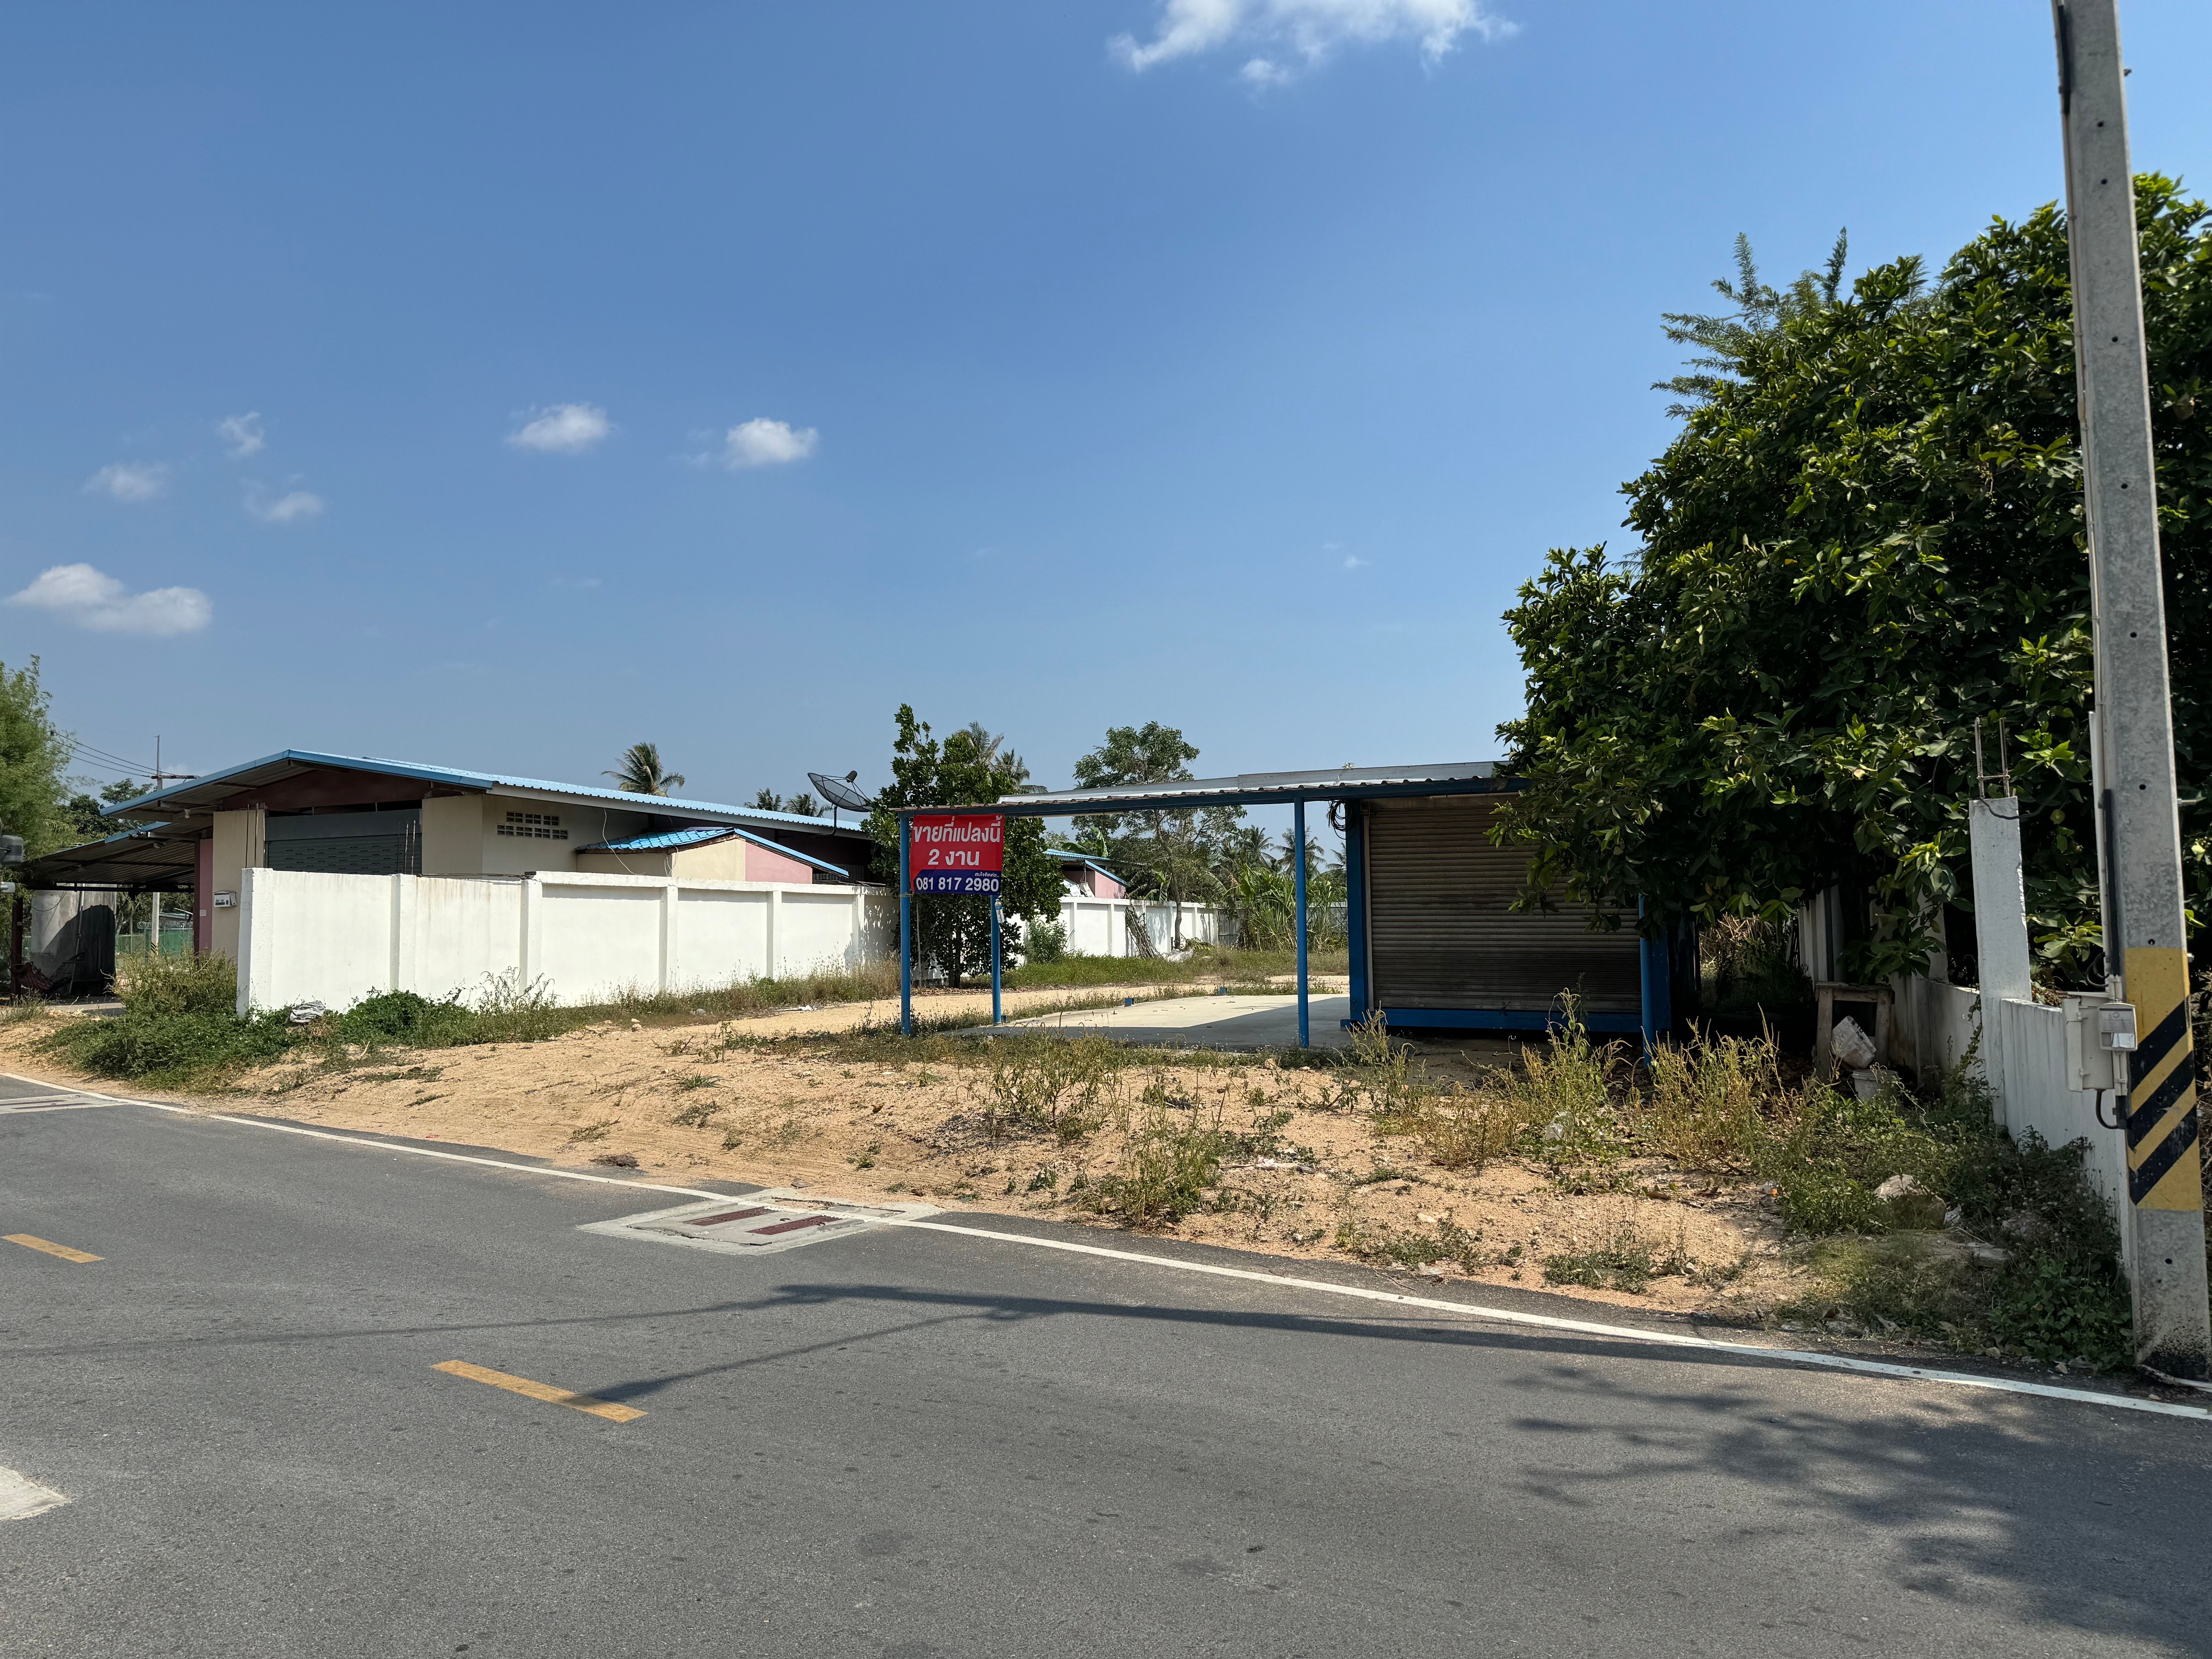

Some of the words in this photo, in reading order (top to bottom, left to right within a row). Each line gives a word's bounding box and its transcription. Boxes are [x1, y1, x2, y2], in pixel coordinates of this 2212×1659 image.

[913, 815, 1002, 843] ขายที่แปลงนี้
[928, 848, 940, 866] 2
[945, 851, 980, 866] งาน
[916, 877, 934, 890] 081
[938, 877, 962, 891] 817
[965, 877, 999, 892] 2980
